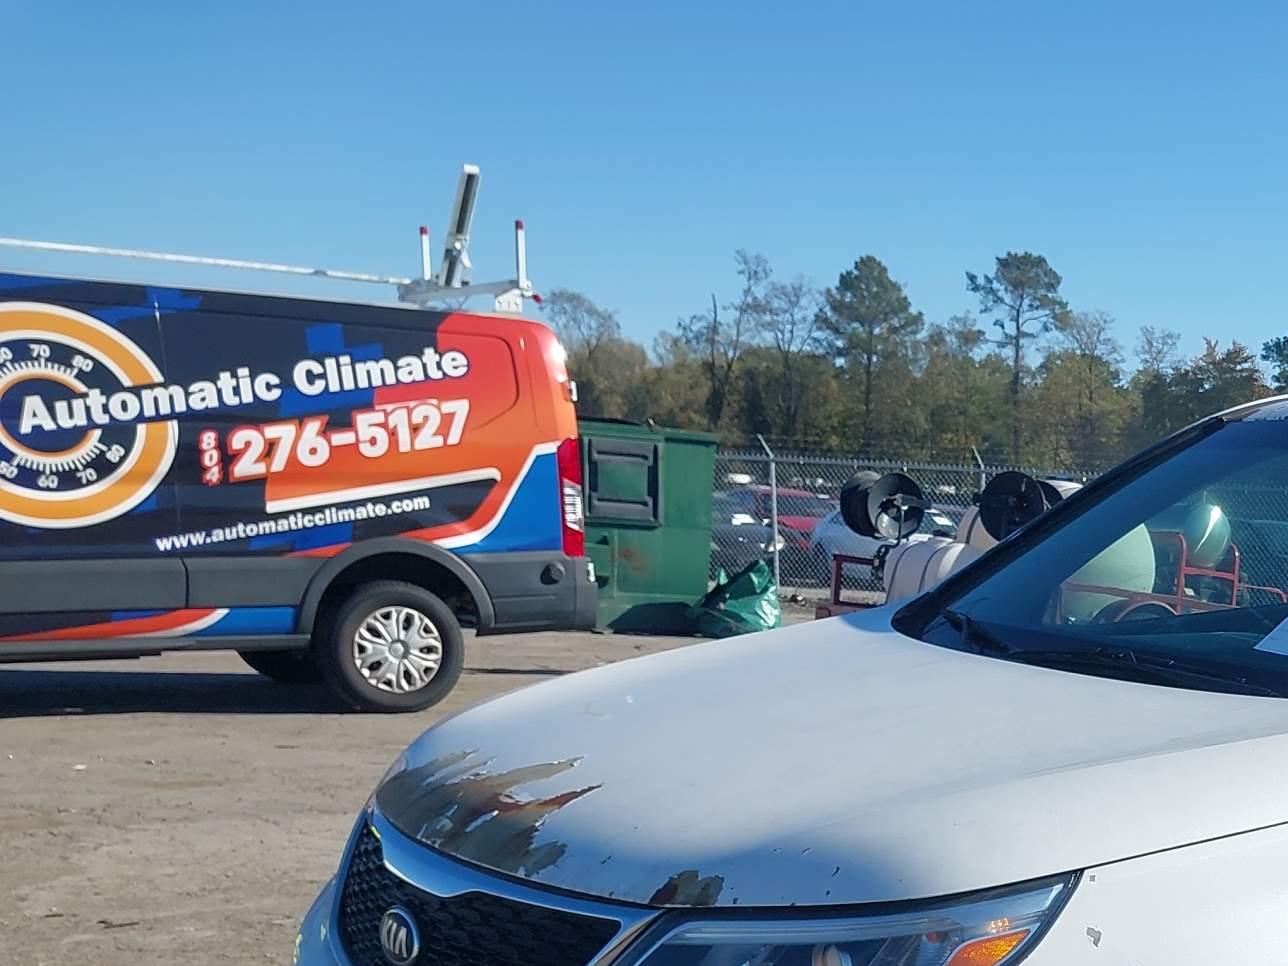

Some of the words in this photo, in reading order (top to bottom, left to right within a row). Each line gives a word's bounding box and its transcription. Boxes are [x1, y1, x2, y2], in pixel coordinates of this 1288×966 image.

[28, 344, 51, 359] 70
[72, 354, 95, 373] 80
[20, 366, 282, 435] Automatic
[293, 346, 469, 397] Climate
[200, 431, 222, 483] 804
[230, 398, 470, 479] 276-5127
[37, 475, 59, 489] 60
[77, 467, 98, 485] 70
[155, 494, 431, 552] www.automaticclimate.com
[383, 914, 409, 959] KIA
